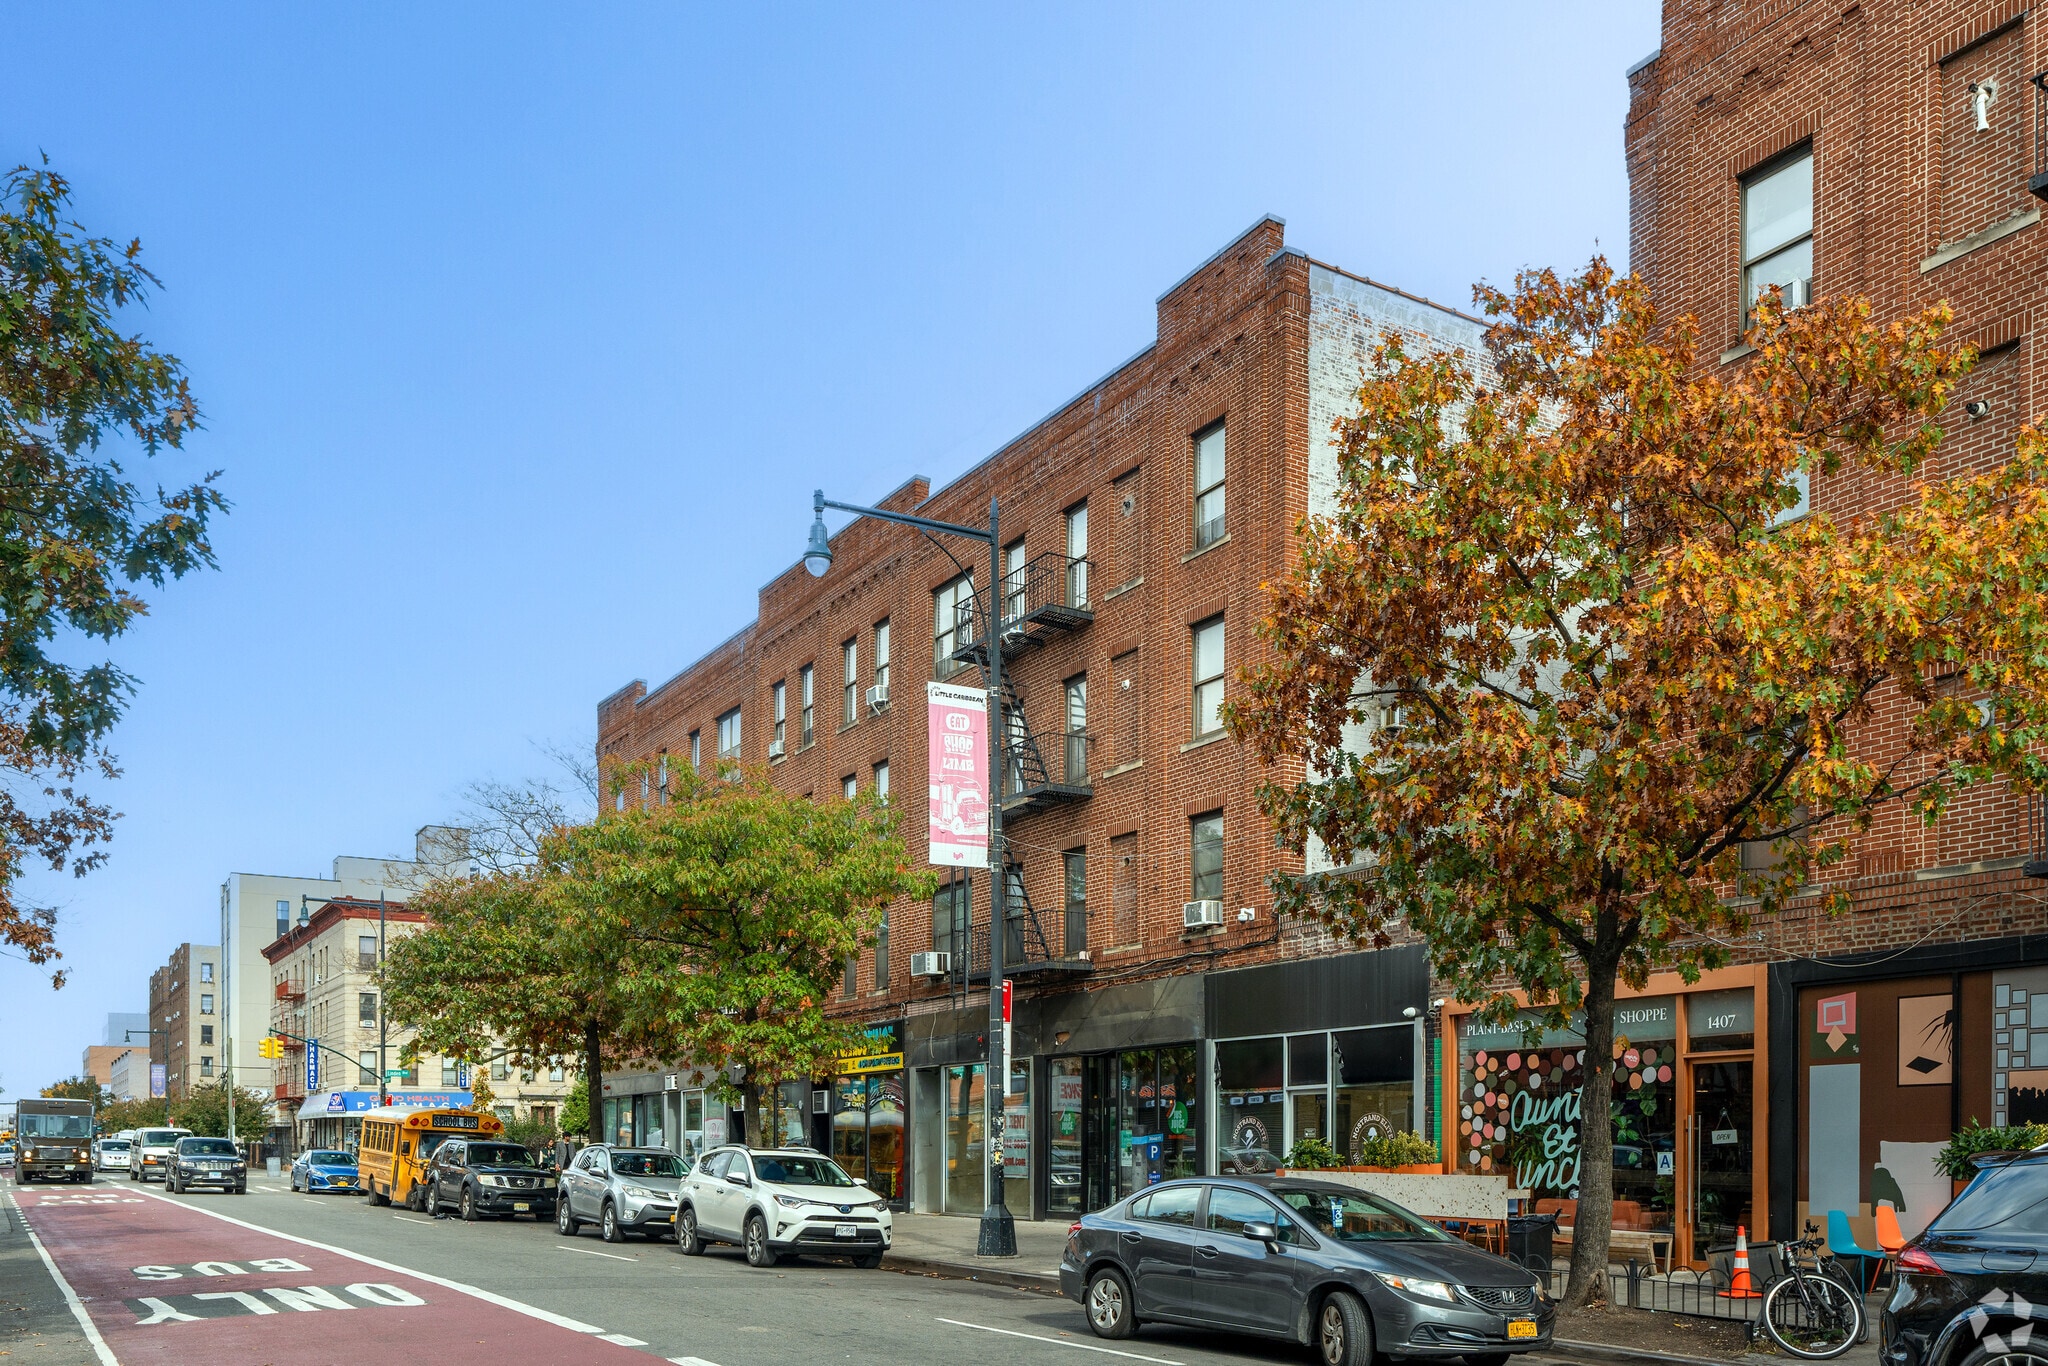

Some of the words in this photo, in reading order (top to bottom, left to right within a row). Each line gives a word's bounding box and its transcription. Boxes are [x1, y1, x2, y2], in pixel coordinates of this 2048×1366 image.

[935, 691, 952, 699] LITTLE
[952, 693, 984, 704] CARIBBEAN
[950, 714, 966, 729] EAT
[944, 735, 974, 754] SHOP
[943, 757, 975, 772] LIME
[1619, 1007, 1667, 1024] SHOPPE
[1707, 1014, 1736, 1029] 1407
[308, 1040, 316, 1089] PHARMACY
[434, 1115, 461, 1126] SCHOOL
[463, 1117, 479, 1128] BUS
[1233, 1117, 1257, 1140] NOSTRAND
[1256, 1120, 1268, 1142] ELITE
[1353, 1114, 1380, 1140] NOSTRAND
[1380, 1118, 1395, 1140] ELITE
[1716, 1132, 1732, 1141] OPEN
[1151, 1145, 1159, 1159] P
[1516, 1148, 1582, 1190] uncl
[1660, 1154, 1671, 1169] A
[133, 1257, 313, 1281] BUS
[135, 1283, 428, 1325] ONLY
